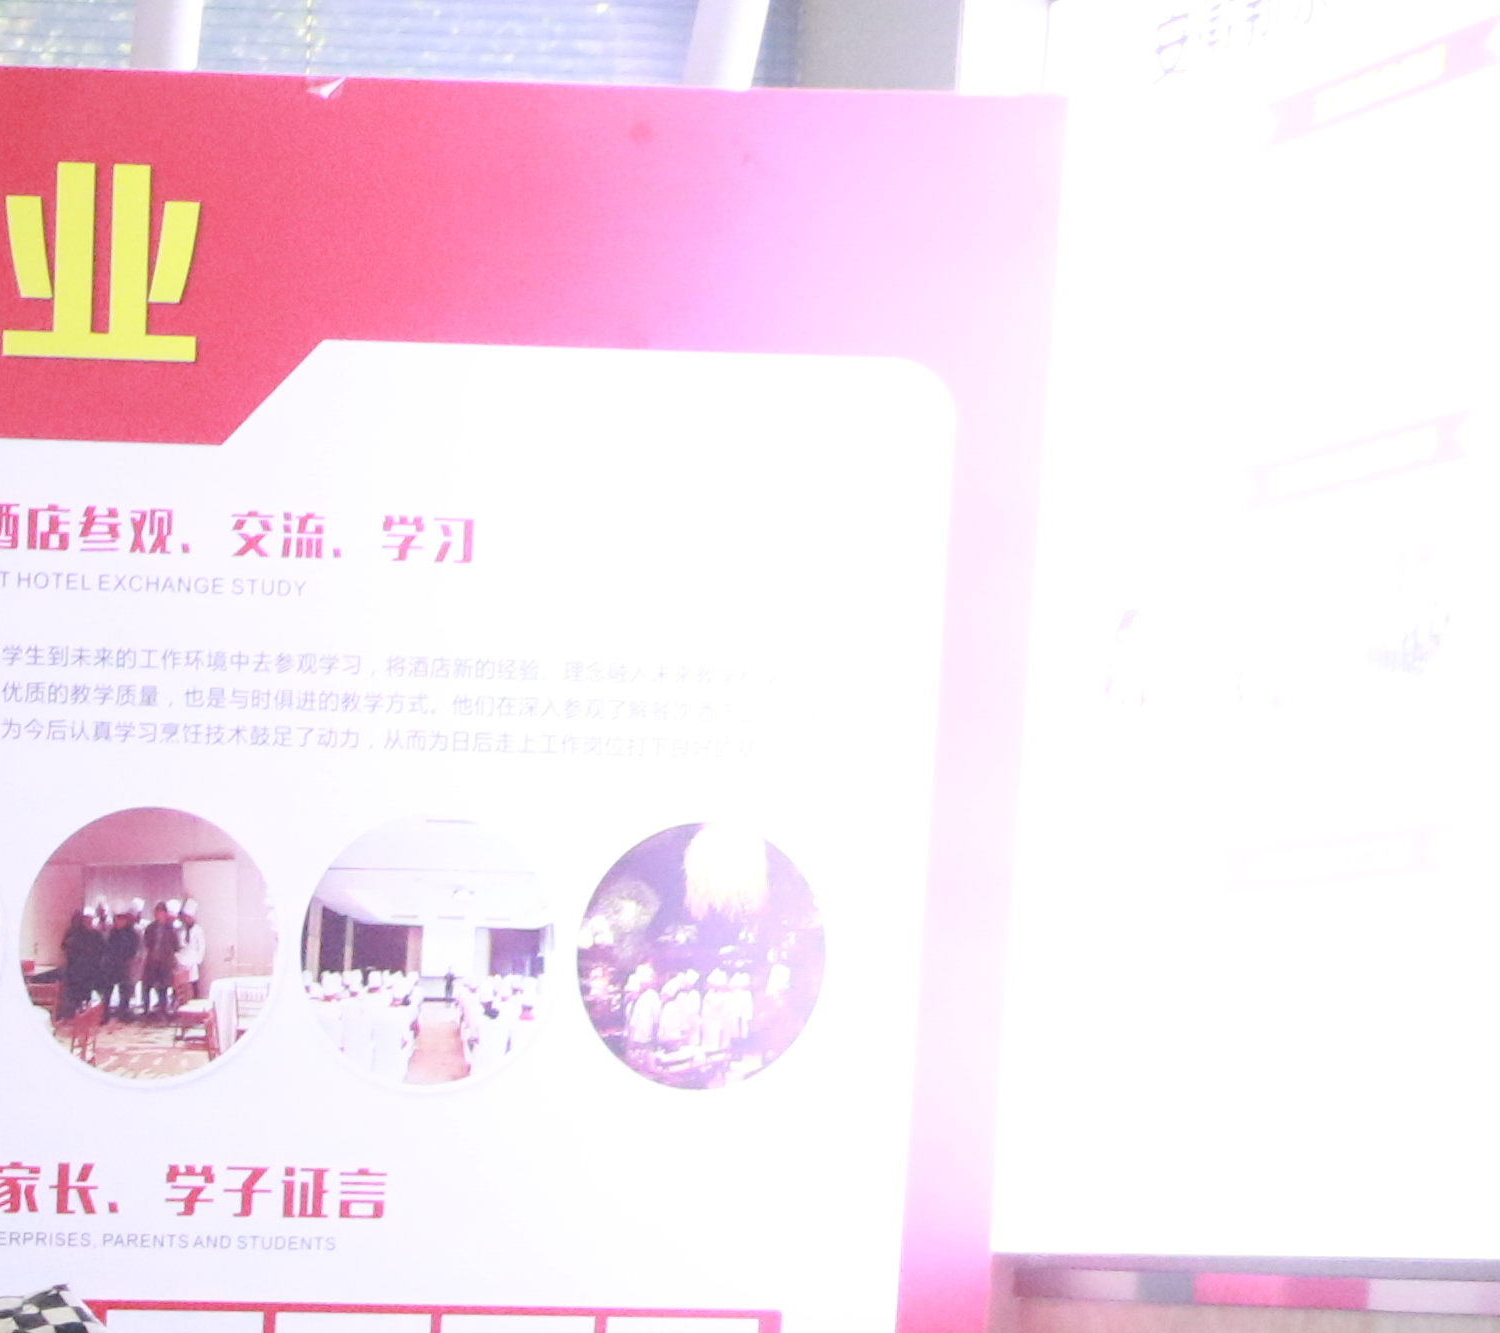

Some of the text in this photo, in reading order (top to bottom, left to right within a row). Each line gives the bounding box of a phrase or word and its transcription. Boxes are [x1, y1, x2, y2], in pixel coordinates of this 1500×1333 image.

[17, 572, 91, 590] HOTEL
[98, 574, 223, 594] EXCHANGE
[232, 578, 306, 596] STUDY
[103, 1233, 188, 1248] PARENTS
[193, 1235, 231, 1249] AND
[237, 1235, 336, 1251] STUDENTS
